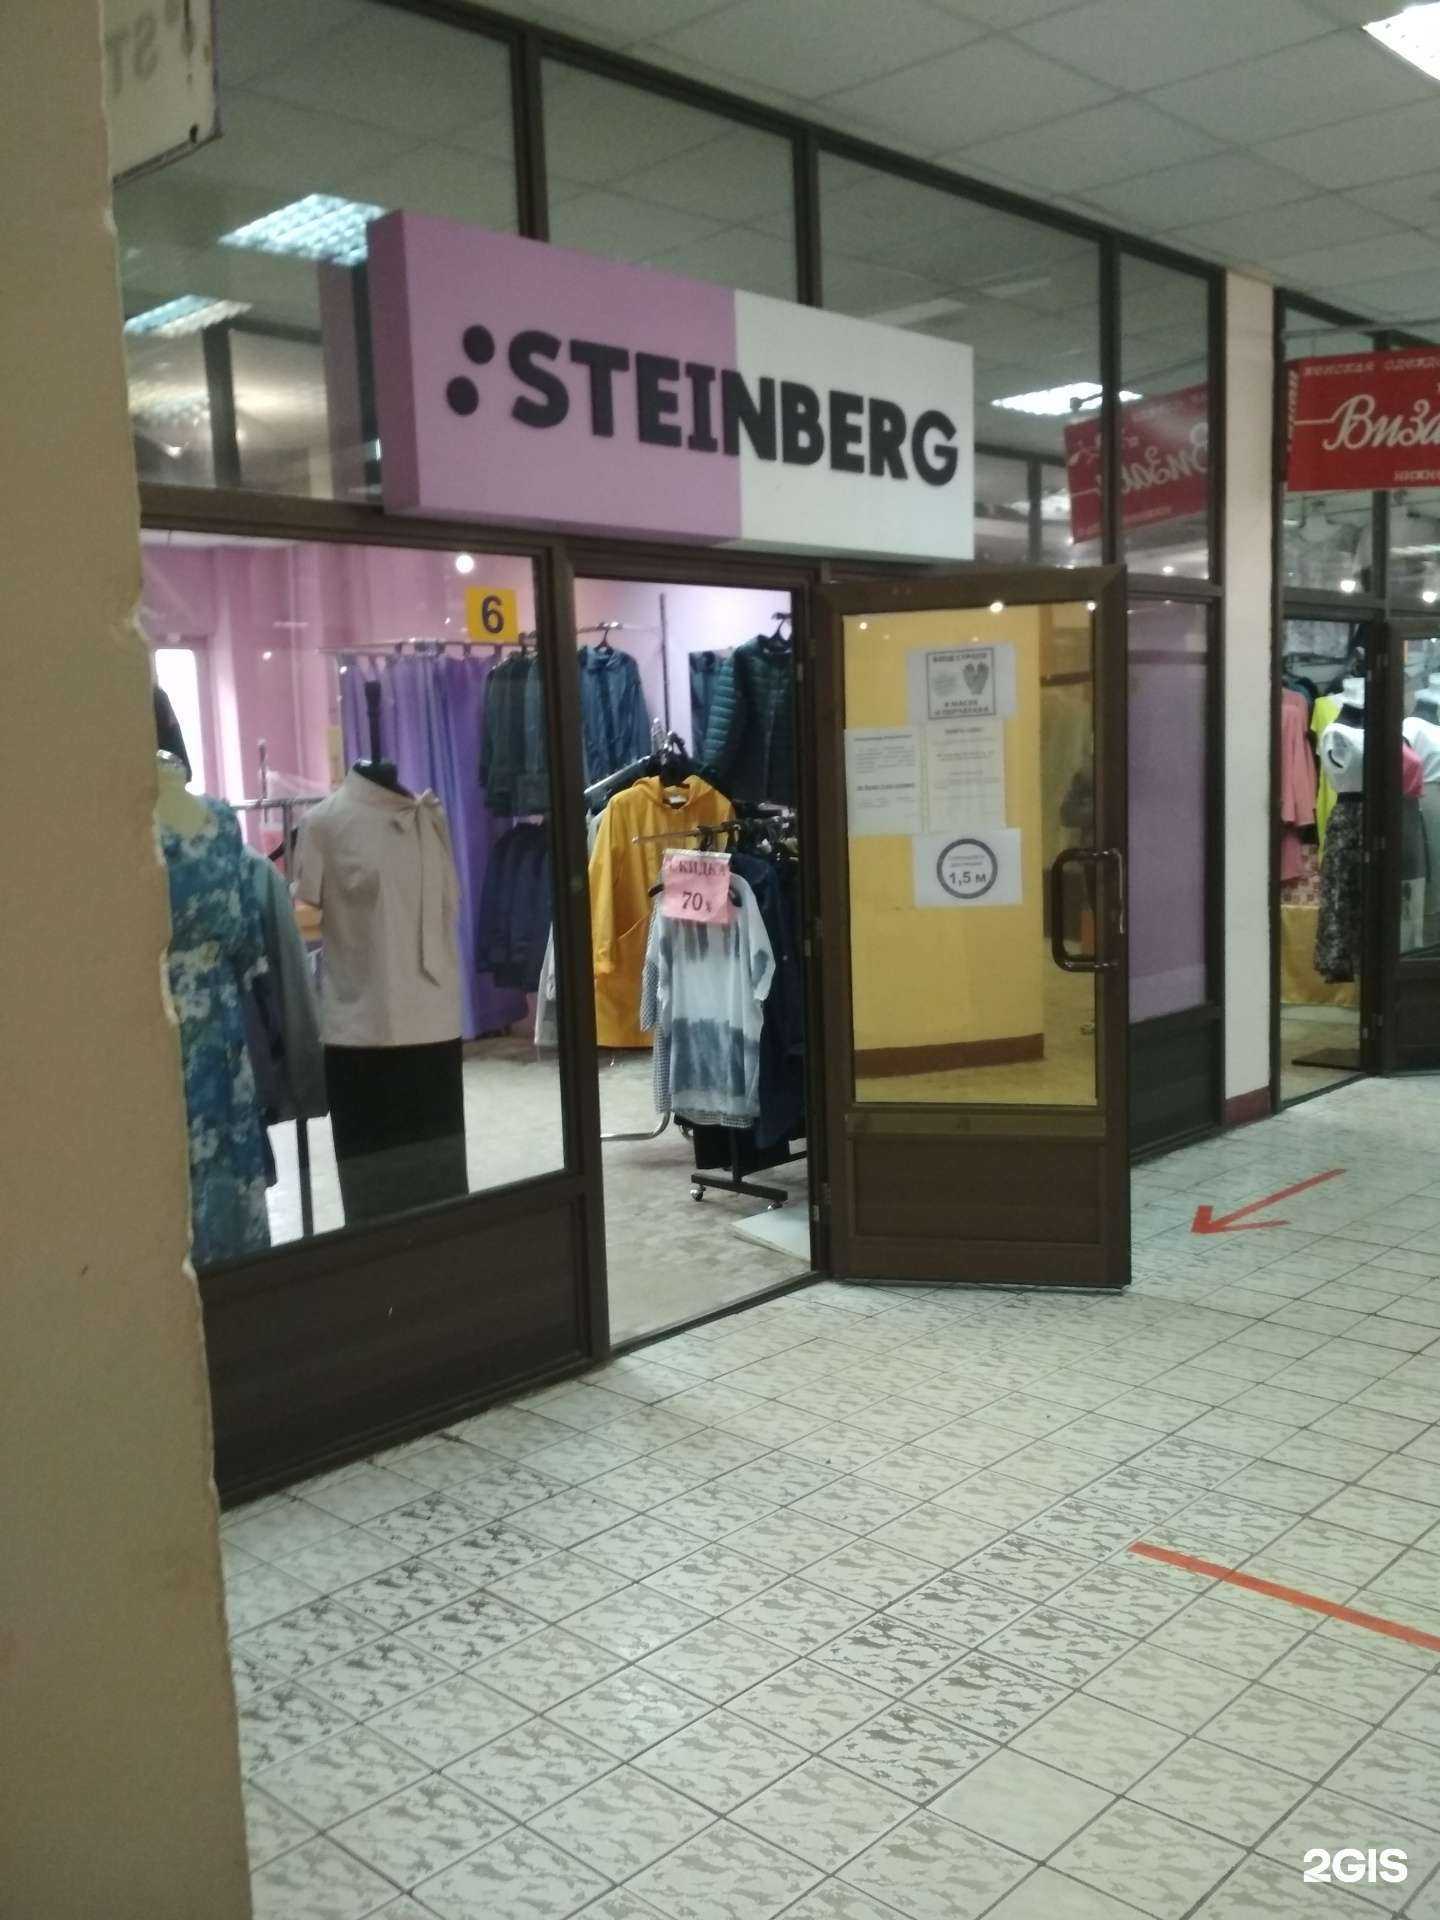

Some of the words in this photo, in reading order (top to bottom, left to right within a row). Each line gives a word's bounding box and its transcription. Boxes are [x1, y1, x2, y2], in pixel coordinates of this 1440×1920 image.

[508, 330, 958, 486] STEINBERG
[481, 595, 505, 634] 6
[949, 871, 972, 887] 1,5
